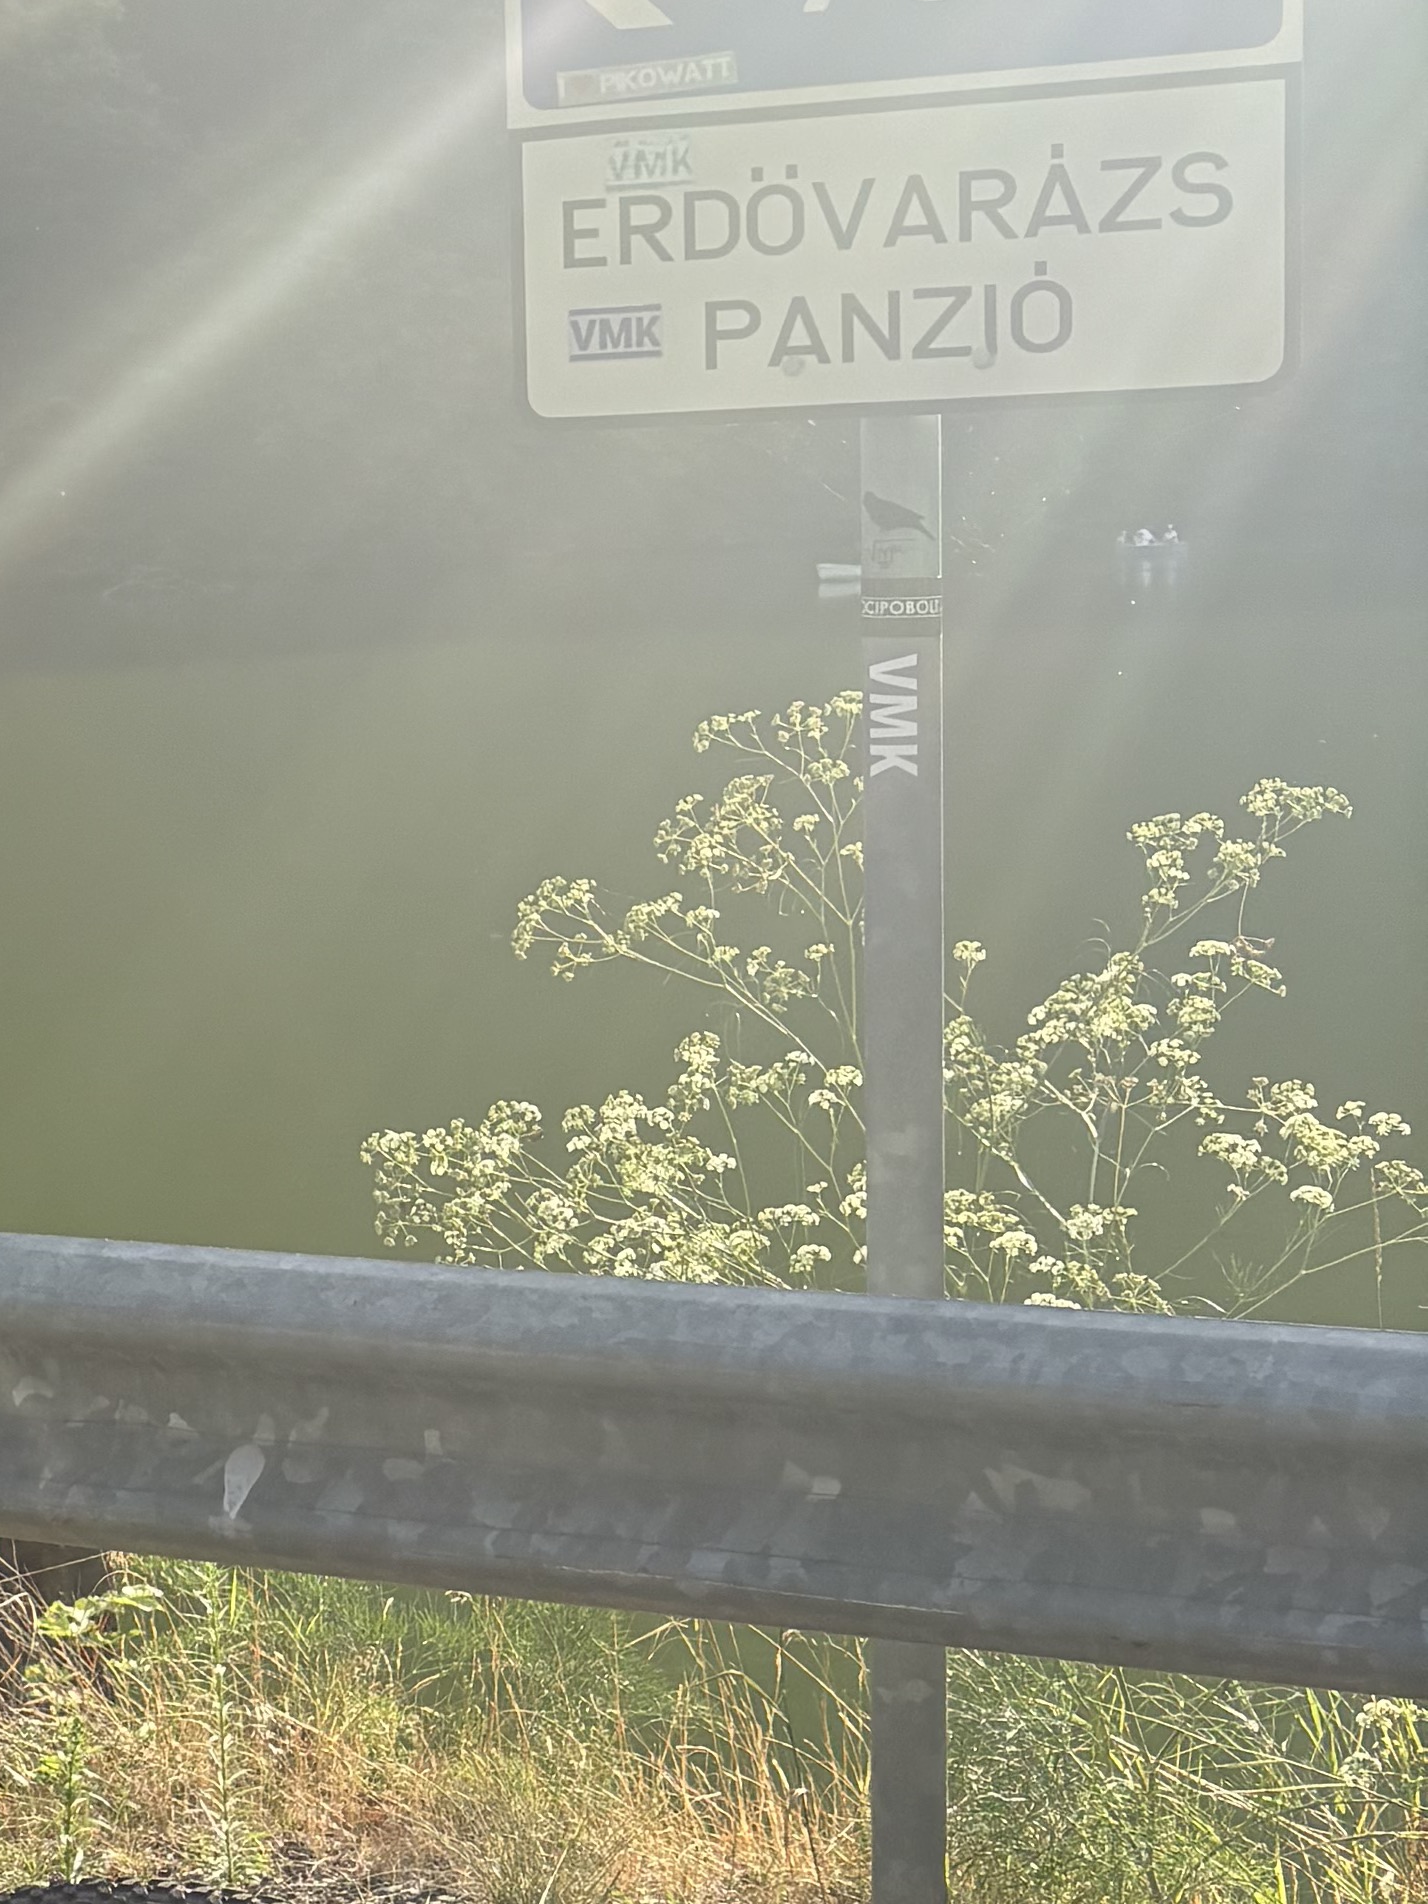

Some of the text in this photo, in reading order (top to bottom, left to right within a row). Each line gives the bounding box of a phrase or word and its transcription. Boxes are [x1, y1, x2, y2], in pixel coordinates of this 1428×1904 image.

[561, 142, 1235, 269] ERDÖVARÁZS
[570, 314, 661, 352] VMK
[703, 259, 1075, 371] PANZIÓ
[869, 653, 918, 777] VMK
